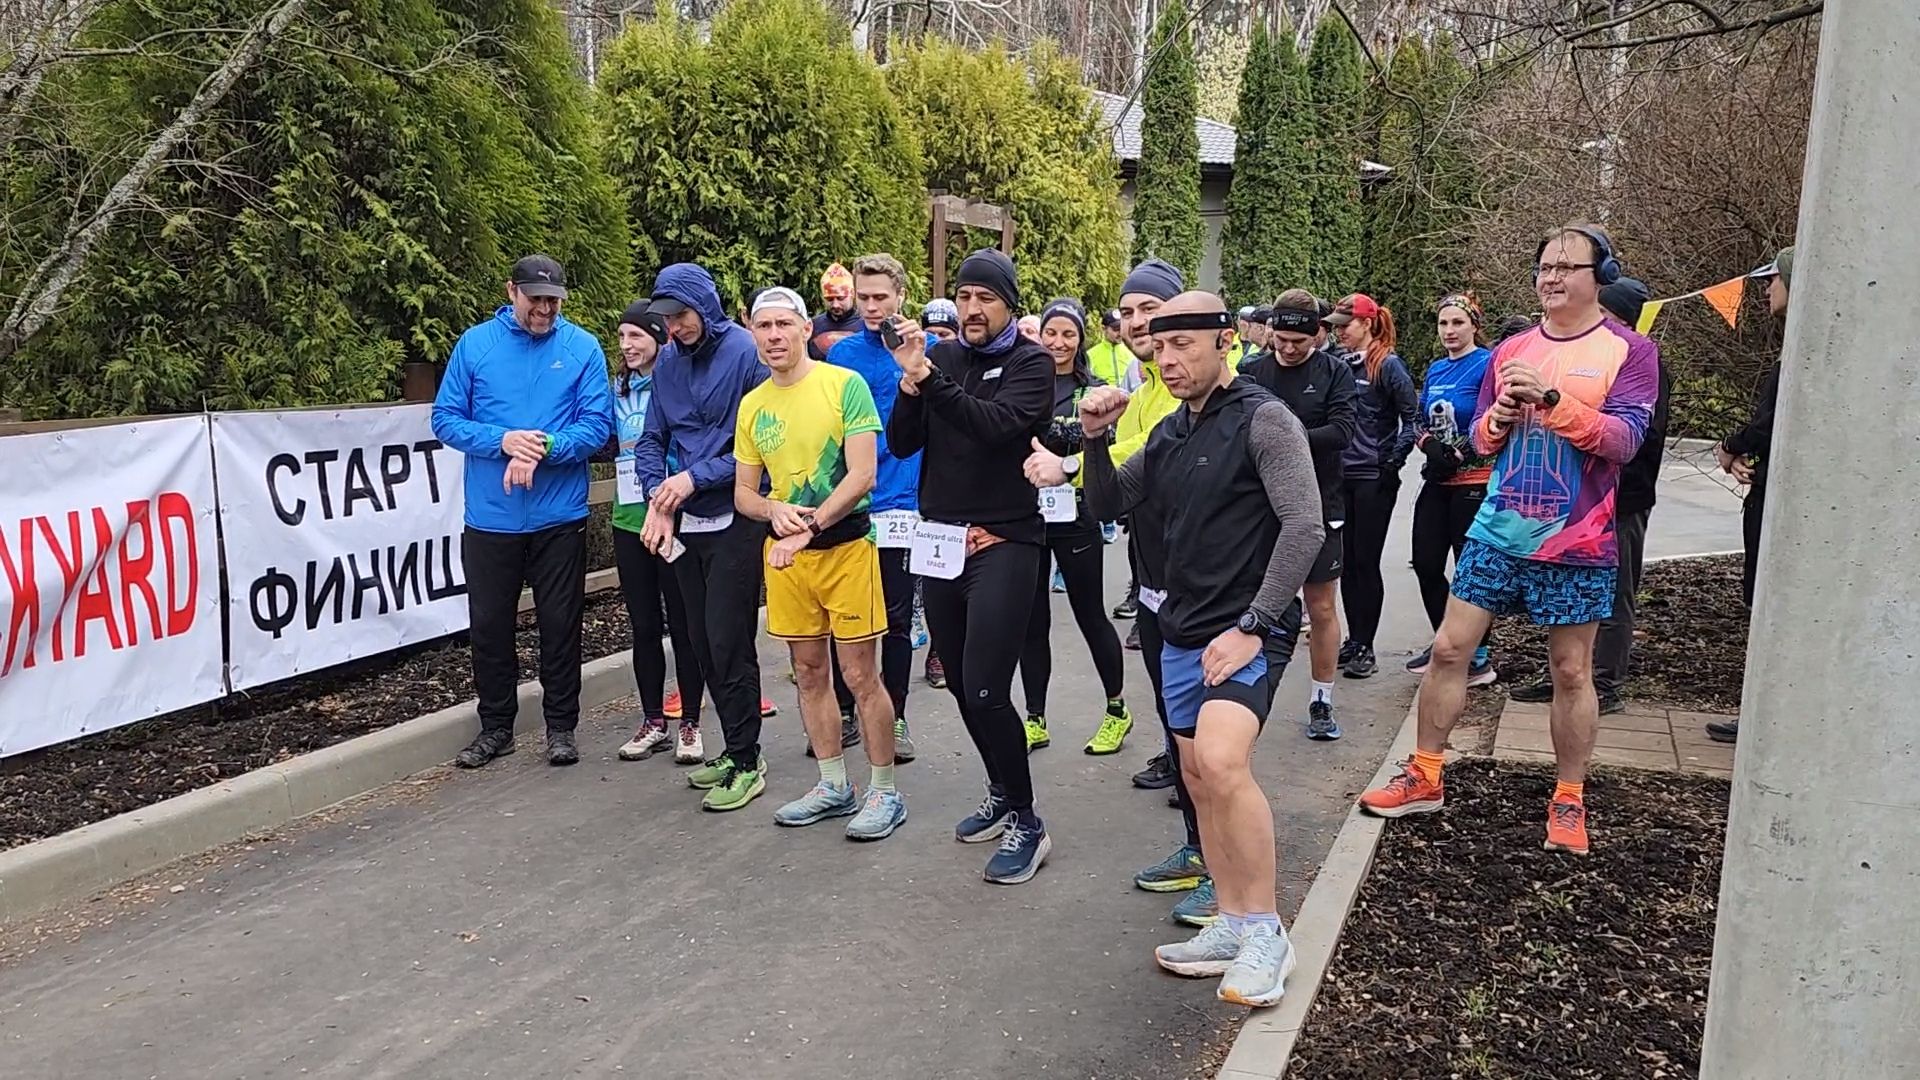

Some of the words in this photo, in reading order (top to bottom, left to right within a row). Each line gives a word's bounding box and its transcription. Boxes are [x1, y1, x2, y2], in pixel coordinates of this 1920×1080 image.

[266, 439, 444, 527] СТАРТ
[888, 521, 909, 534] 25
[916, 530, 946, 541] Backyard
[947, 535, 963, 544] ultra
[933, 544, 941, 559] 1
[926, 560, 947, 569] SPACE
[249, 533, 467, 639] ФИНИШ
